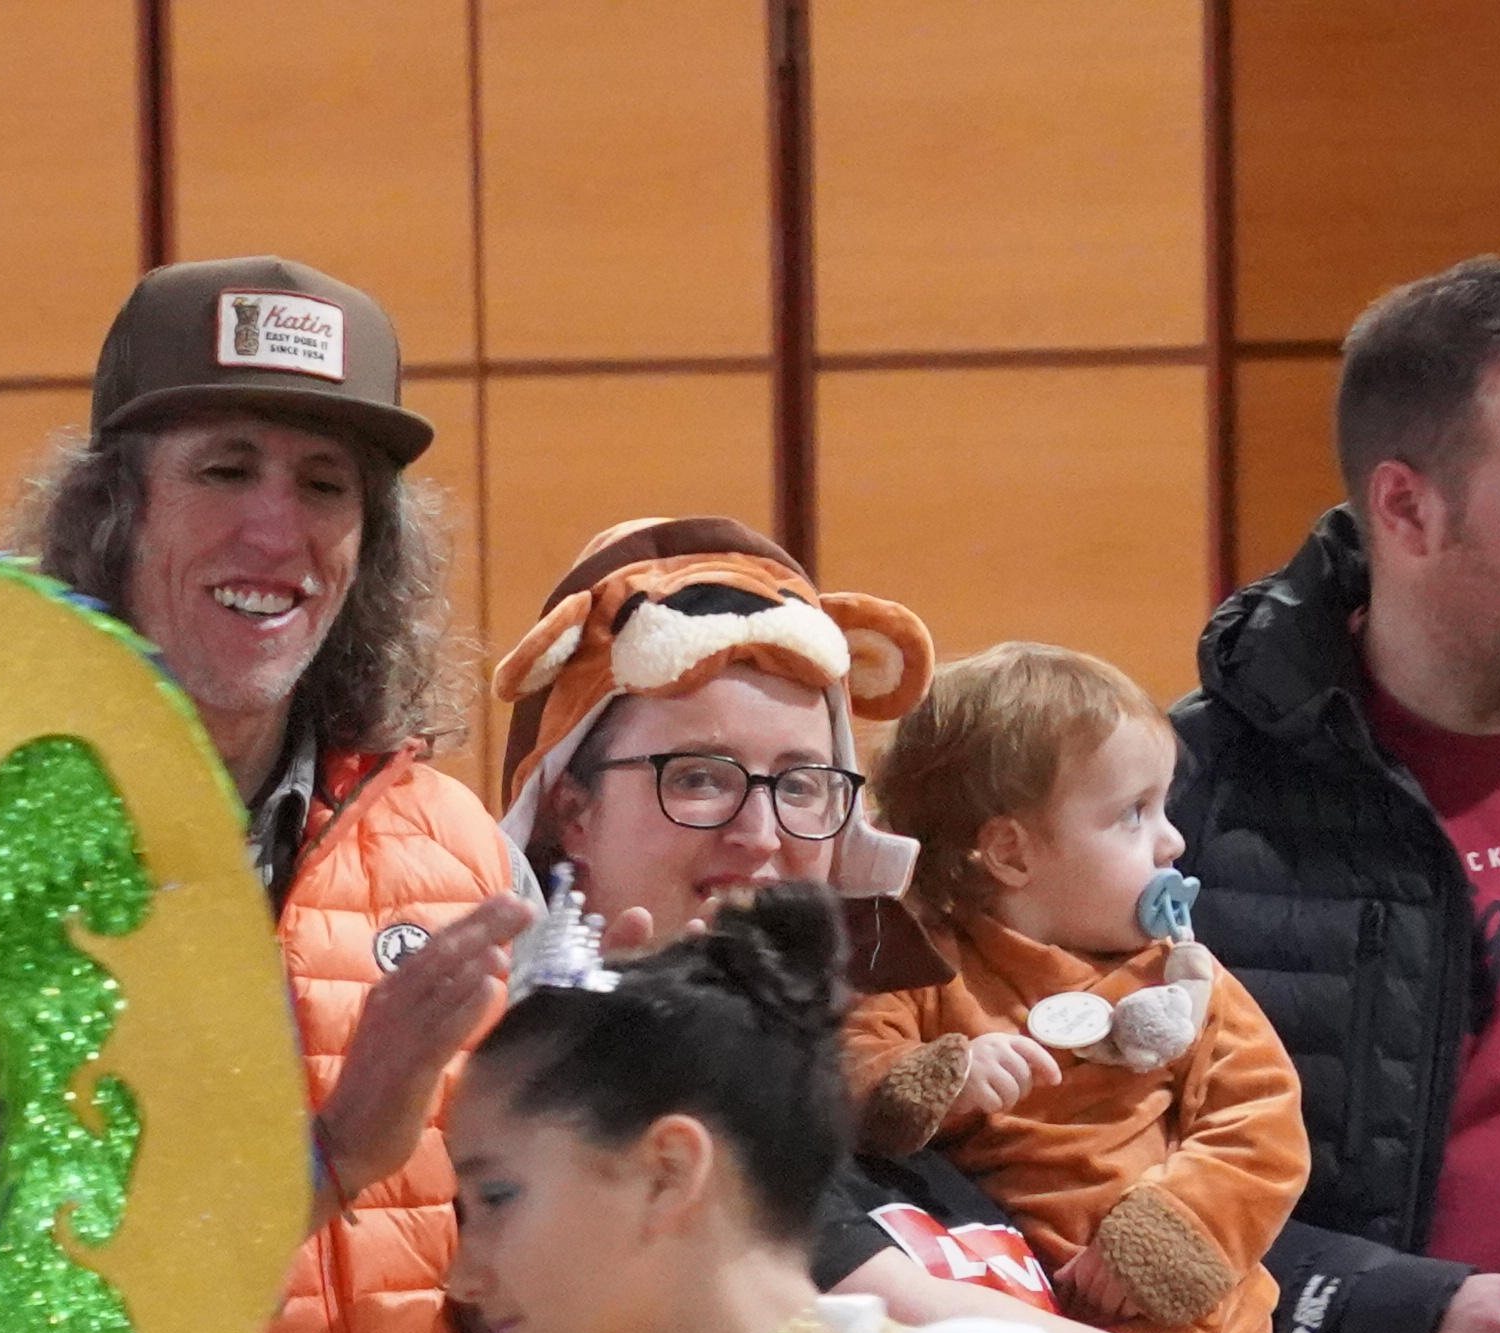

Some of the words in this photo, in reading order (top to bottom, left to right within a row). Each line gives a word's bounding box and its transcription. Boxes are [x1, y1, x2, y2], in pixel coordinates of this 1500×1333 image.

[262, 305, 333, 338] Katin
[265, 331, 290, 342] EASY
[293, 335, 317, 348] DOES
[270, 343, 299, 356] SINCE
